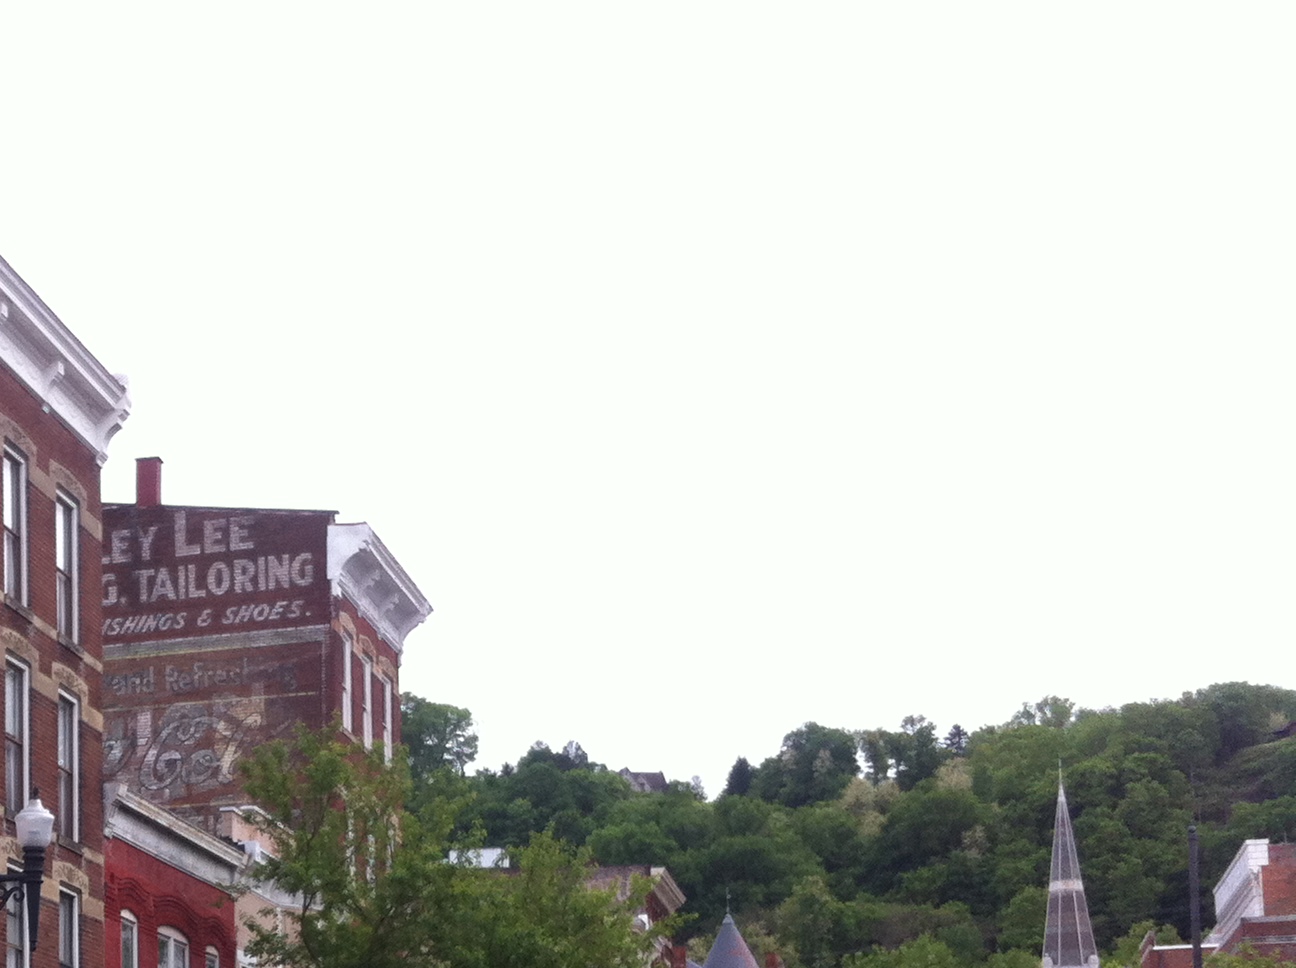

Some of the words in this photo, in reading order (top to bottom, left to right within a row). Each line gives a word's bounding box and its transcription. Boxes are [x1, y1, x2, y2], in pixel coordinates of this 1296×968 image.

[102, 526, 157, 564] EY
[173, 510, 255, 557] LEE
[135, 552, 315, 604] TAILORING
[196, 608, 213, 628] &
